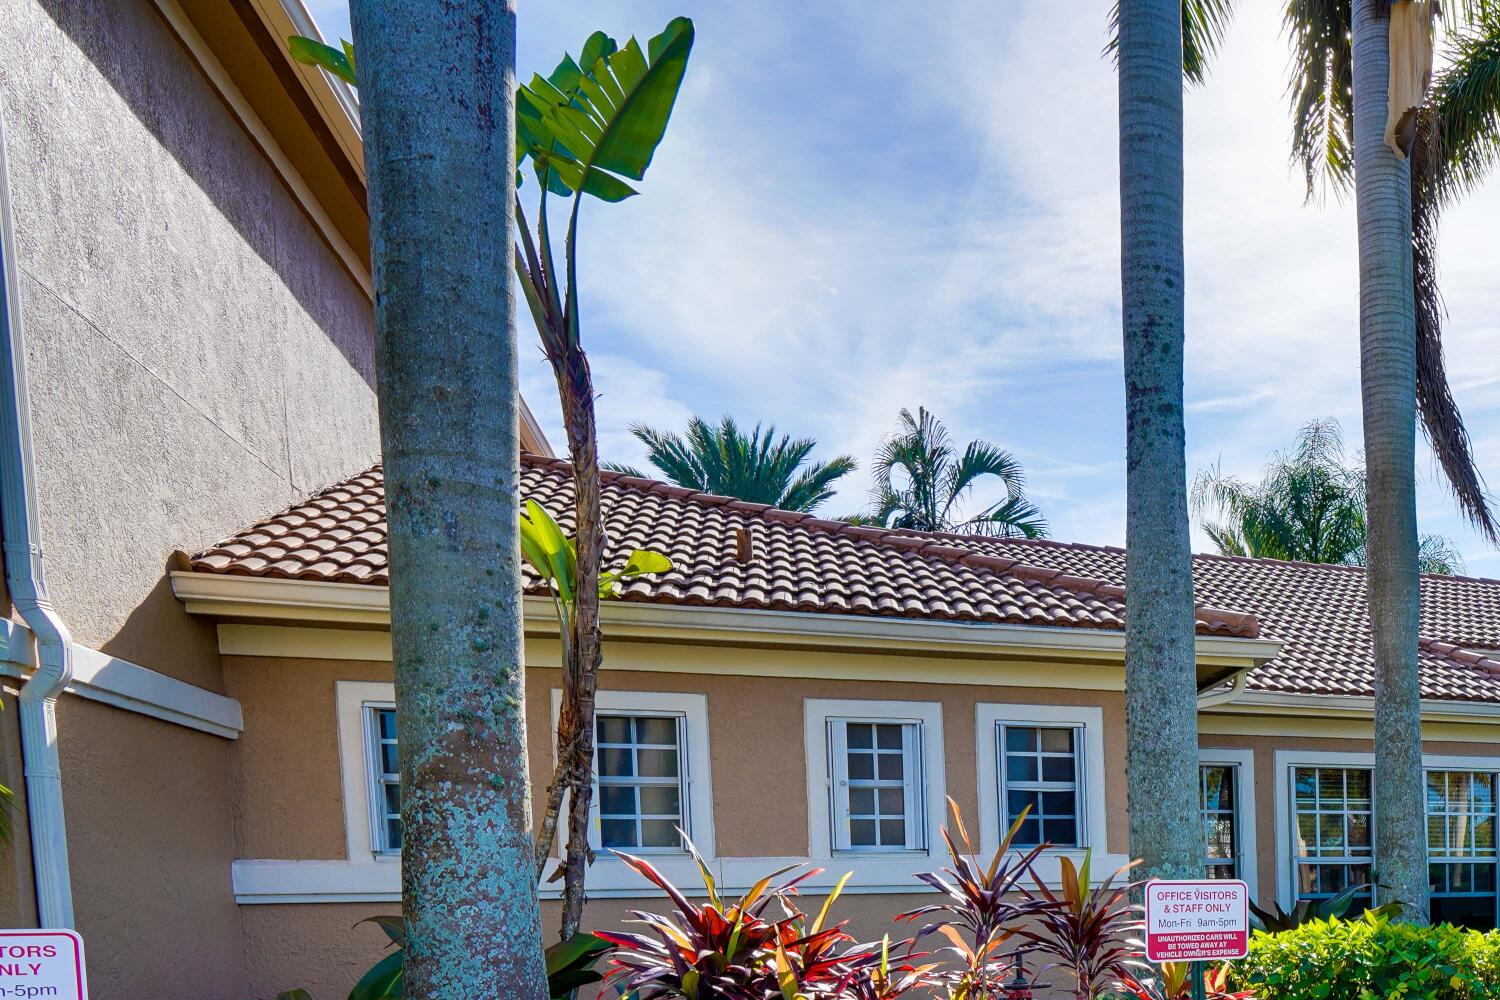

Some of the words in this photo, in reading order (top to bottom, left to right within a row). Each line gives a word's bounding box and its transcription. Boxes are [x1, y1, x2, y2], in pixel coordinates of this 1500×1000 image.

[1157, 891, 1192, 900] OFFICE
[1194, 891, 1238, 900] VISITORS
[1164, 904, 1170, 913] &
[1173, 904, 1203, 913] STAFF
[1205, 903, 1231, 912] ONLY
[1158, 918, 1191, 928] Mon-Fri
[1197, 918, 1237, 928] 9am-5pm
[1183, 949, 1211, 957] OWNER'S
[1211, 948, 1239, 956] EXPENSE
